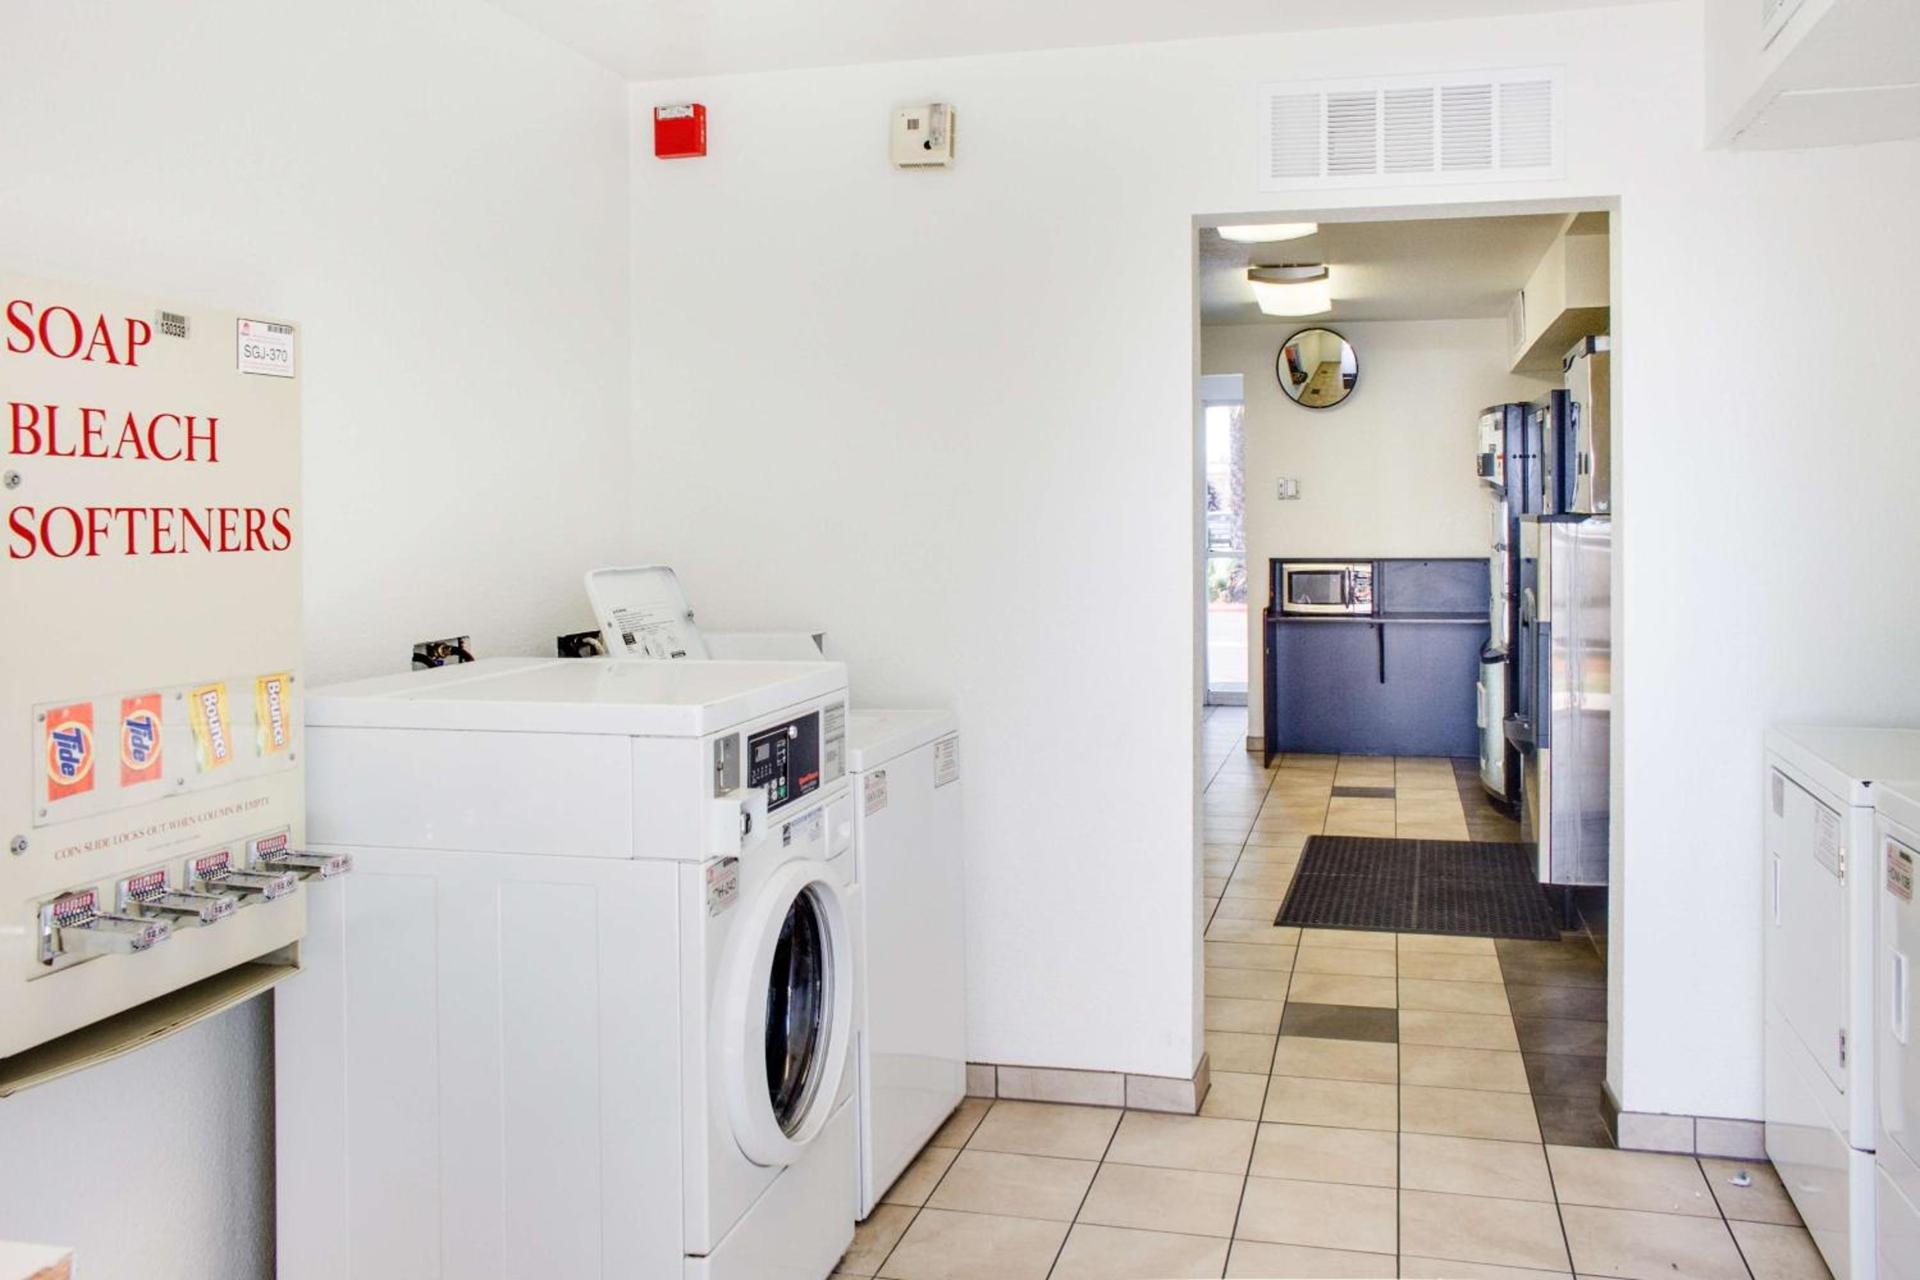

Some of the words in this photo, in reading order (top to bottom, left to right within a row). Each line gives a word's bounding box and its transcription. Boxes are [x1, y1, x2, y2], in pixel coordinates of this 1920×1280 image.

[6, 299, 151, 367] SOAP
[8, 401, 219, 463] BLEACH
[8, 505, 292, 560] SOFTENERS
[127, 716, 153, 762] Tide
[201, 691, 226, 759] Bounce
[266, 680, 284, 746] Bounce
[53, 727, 84, 777] Tide
[146, 822, 168, 836] OUT
